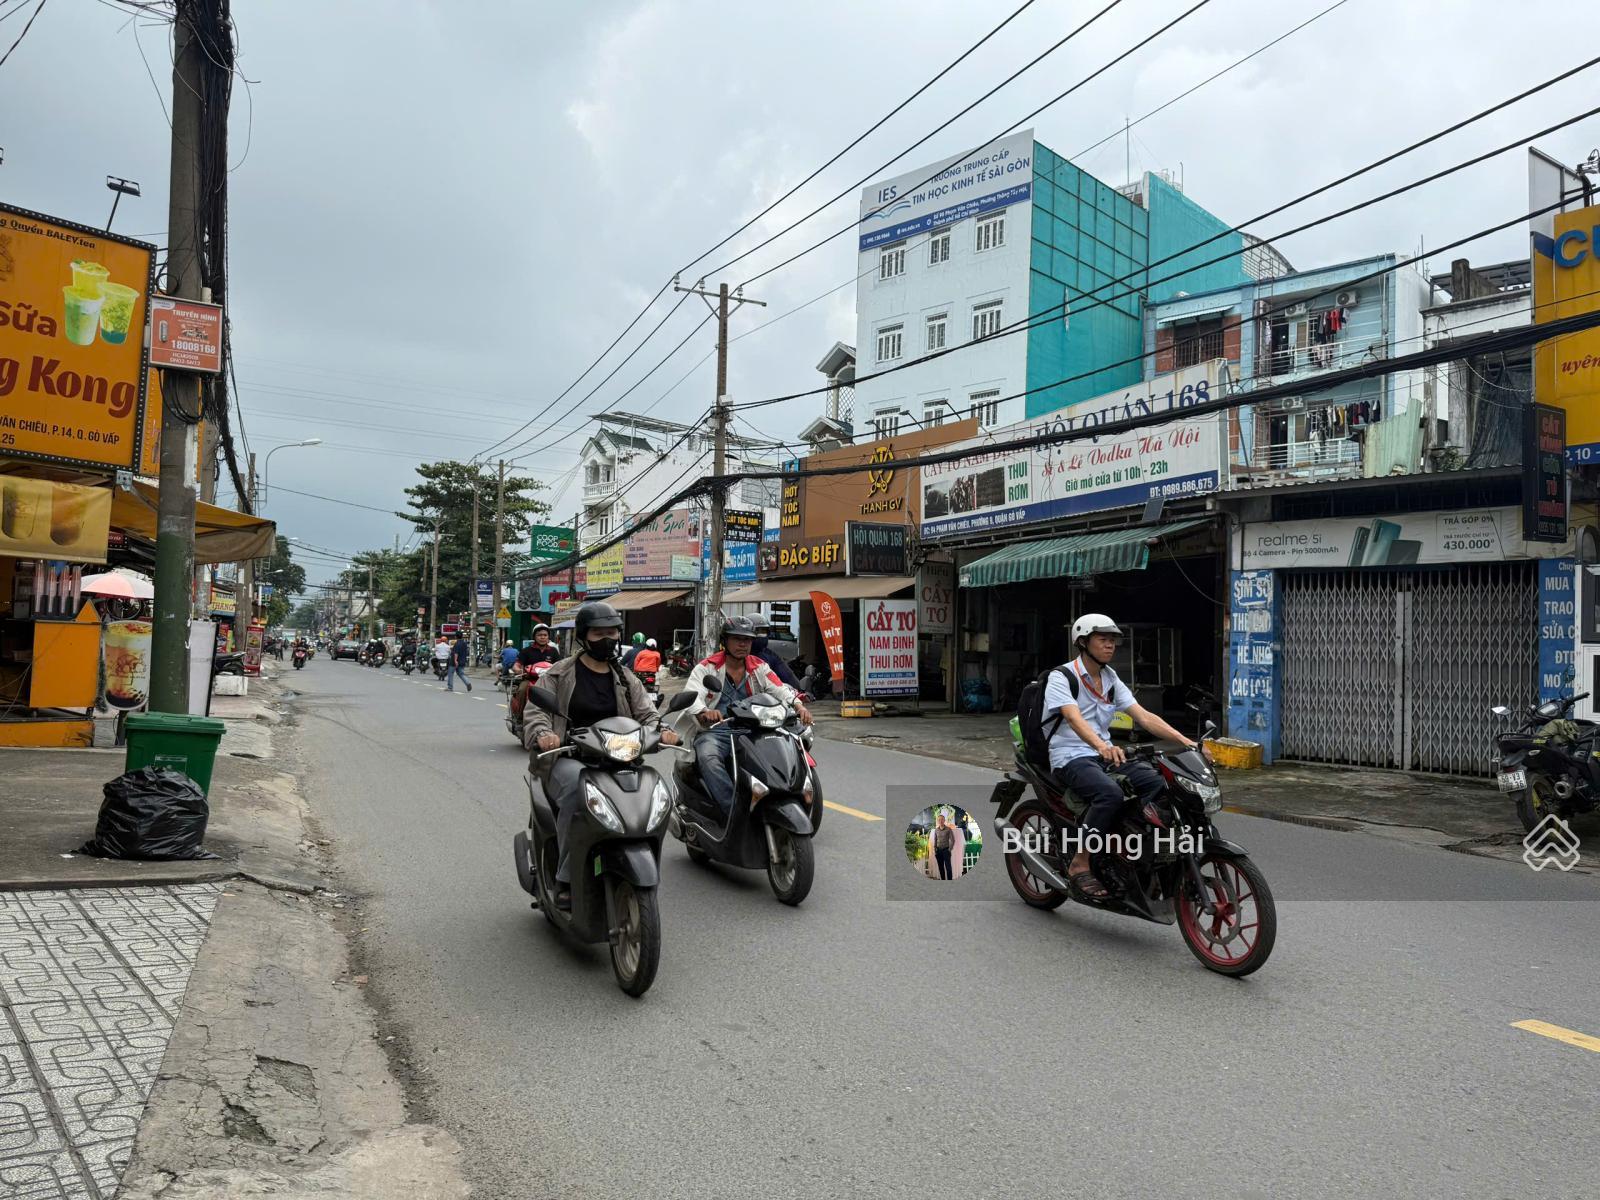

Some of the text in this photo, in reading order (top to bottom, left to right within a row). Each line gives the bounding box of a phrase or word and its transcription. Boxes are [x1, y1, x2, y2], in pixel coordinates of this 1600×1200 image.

[963, 157, 990, 172] TRUNG
[912, 157, 1030, 205] TIN HỌC KINH TẾ SÀI GÒN
[878, 185, 897, 203] IES
[28, 355, 135, 418] Kong
[2, 434, 15, 445] 25
[1087, 444, 1133, 466] Vodka
[1138, 436, 1164, 455] Hà
[1168, 426, 1201, 448] Nội
[1008, 460, 1028, 480] THUI
[1065, 477, 1078, 492] Giờ
[1124, 465, 1141, 480] 10h
[1150, 459, 1169, 476] 23h
[1008, 483, 1029, 503] RƠM
[1162, 477, 1213, 496] 0989.686.675
[859, 501, 888, 515] THANH
[663, 513, 685, 534] Spa
[782, 515, 800, 527] NAM
[890, 530, 903, 547] 168
[1258, 533, 1322, 547] realme 5i
[780, 543, 809, 569] ĐẶC
[811, 539, 840, 567] BIỆT
[1545, 577, 1570, 591] MUA
[867, 601, 916, 631] CẦY TƠ
[1544, 601, 1574, 615] TRAO
[1542, 620, 1565, 639] SỬA
[869, 636, 915, 651] NAM ĐỊNH
[869, 654, 913, 669] THUI RƠM
